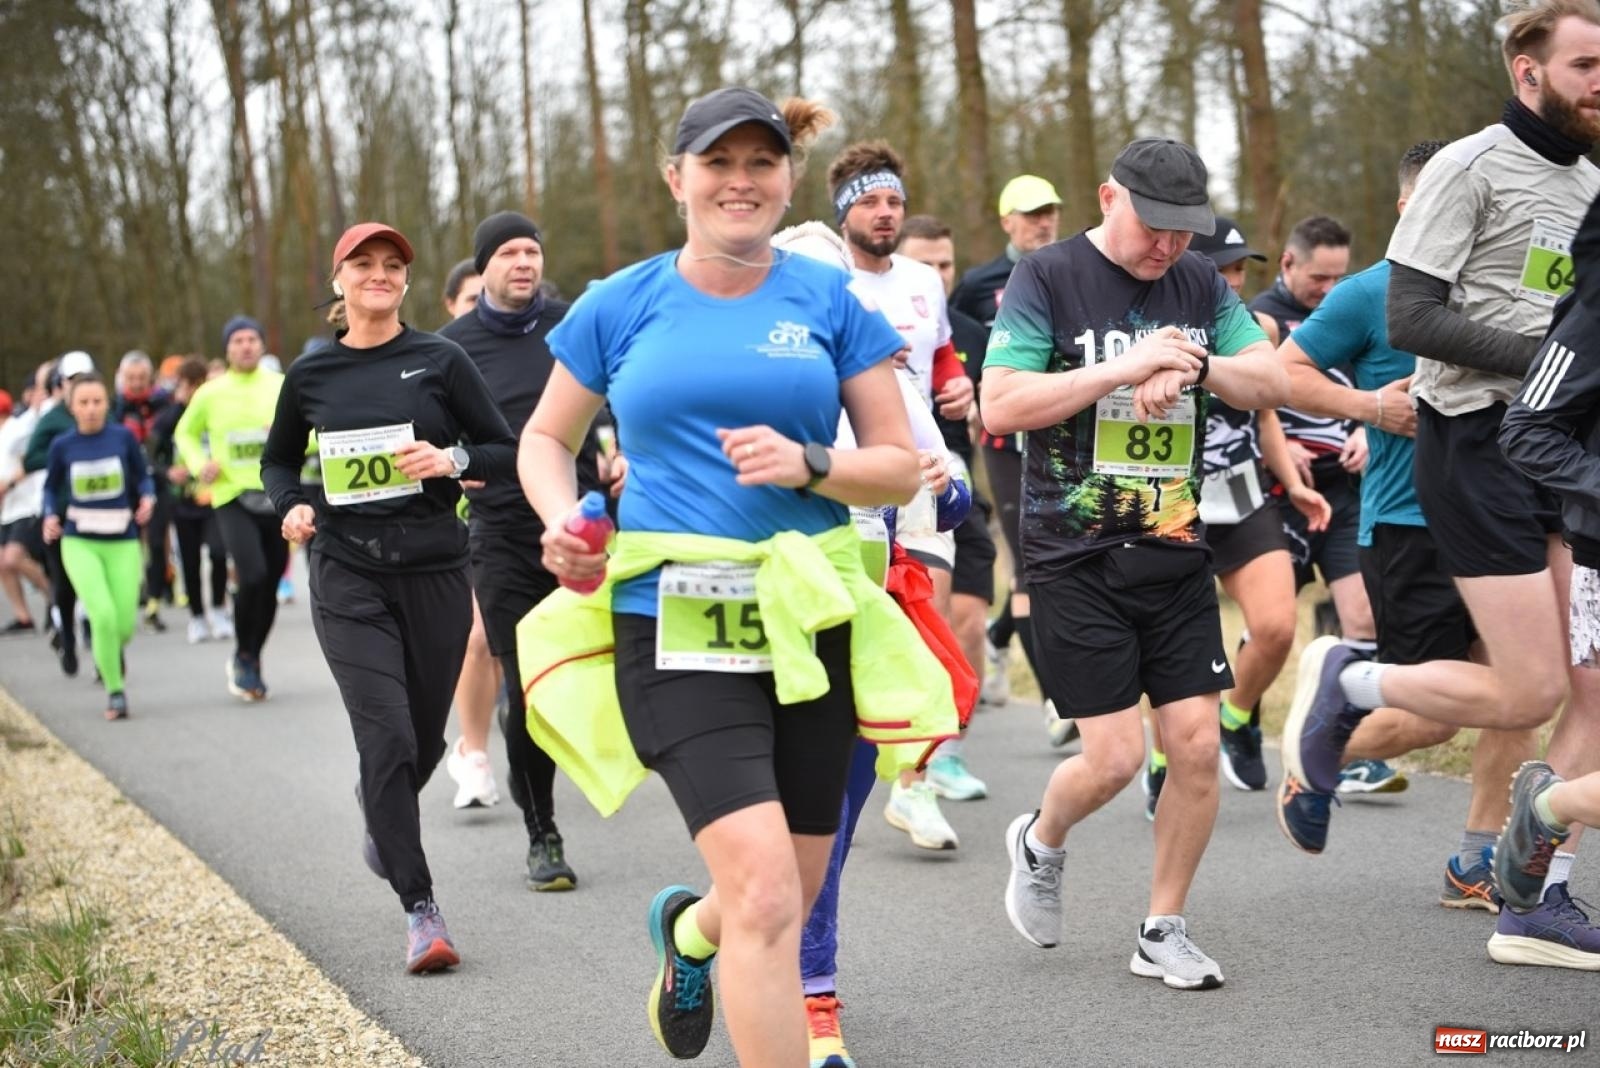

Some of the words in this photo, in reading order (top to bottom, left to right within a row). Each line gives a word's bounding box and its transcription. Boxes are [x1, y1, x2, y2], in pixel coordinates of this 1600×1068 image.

[1126, 425, 1173, 462] 83
[345, 455, 394, 489] 20
[703, 603, 768, 650] 15
